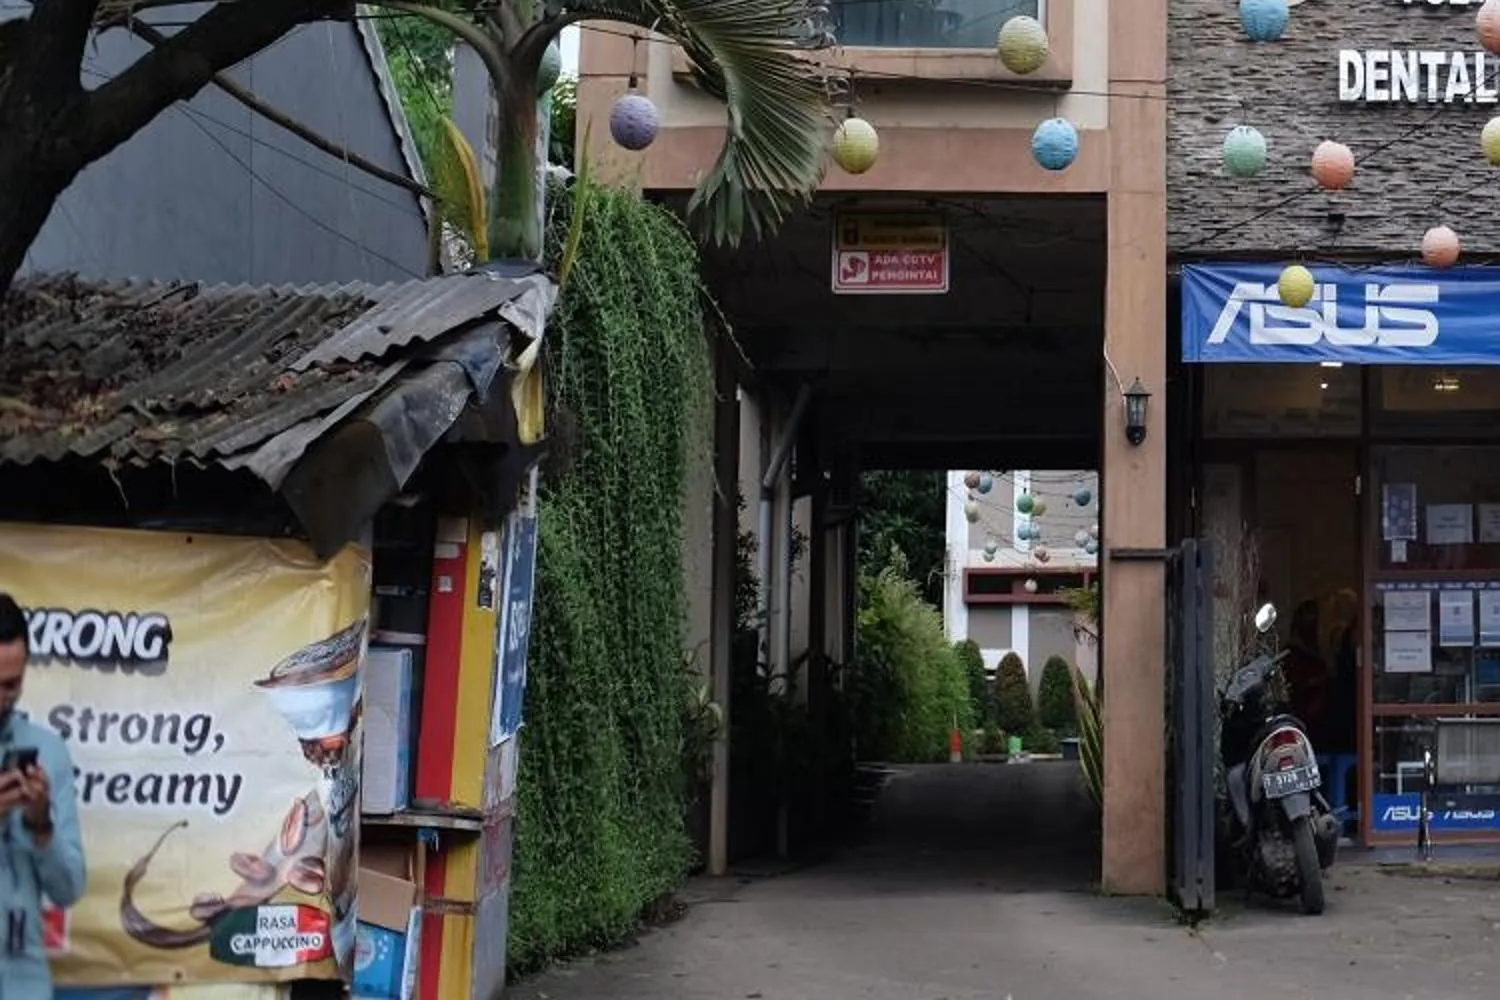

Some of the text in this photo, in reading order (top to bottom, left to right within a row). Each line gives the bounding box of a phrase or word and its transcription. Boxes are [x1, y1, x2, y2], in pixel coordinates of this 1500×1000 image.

[1339, 51, 1498, 103] DENTAL
[875, 255, 899, 265] ADA
[1207, 282, 1439, 347] ASUS
[73, 766, 243, 815] reamy
[259, 916, 297, 930] RASA
[232, 936, 321, 951] CAPPUCCINO
